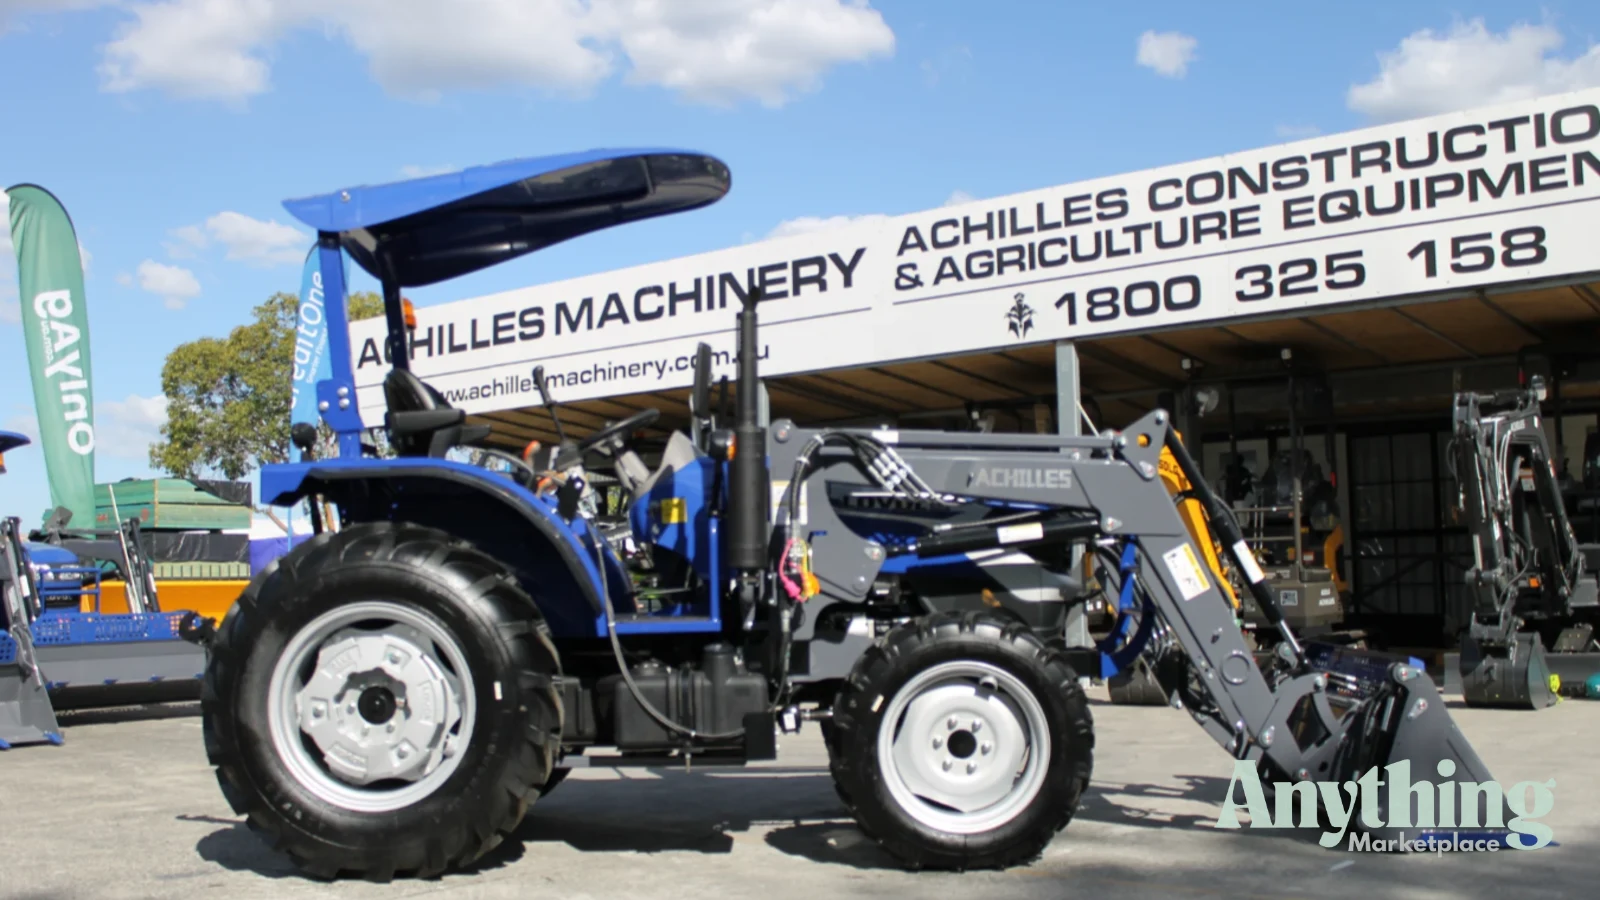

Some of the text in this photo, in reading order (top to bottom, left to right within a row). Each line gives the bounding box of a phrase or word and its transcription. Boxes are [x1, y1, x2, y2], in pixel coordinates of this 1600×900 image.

[896, 104, 1600, 257] ACHILLES CONSTRUCTIO
[554, 246, 867, 337] MACHINERY
[894, 262, 924, 291] &
[933, 204, 1262, 286] AGRICULTURE
[1054, 225, 1548, 326] 1800 325 158
[973, 468, 1072, 489] ACHILLES
